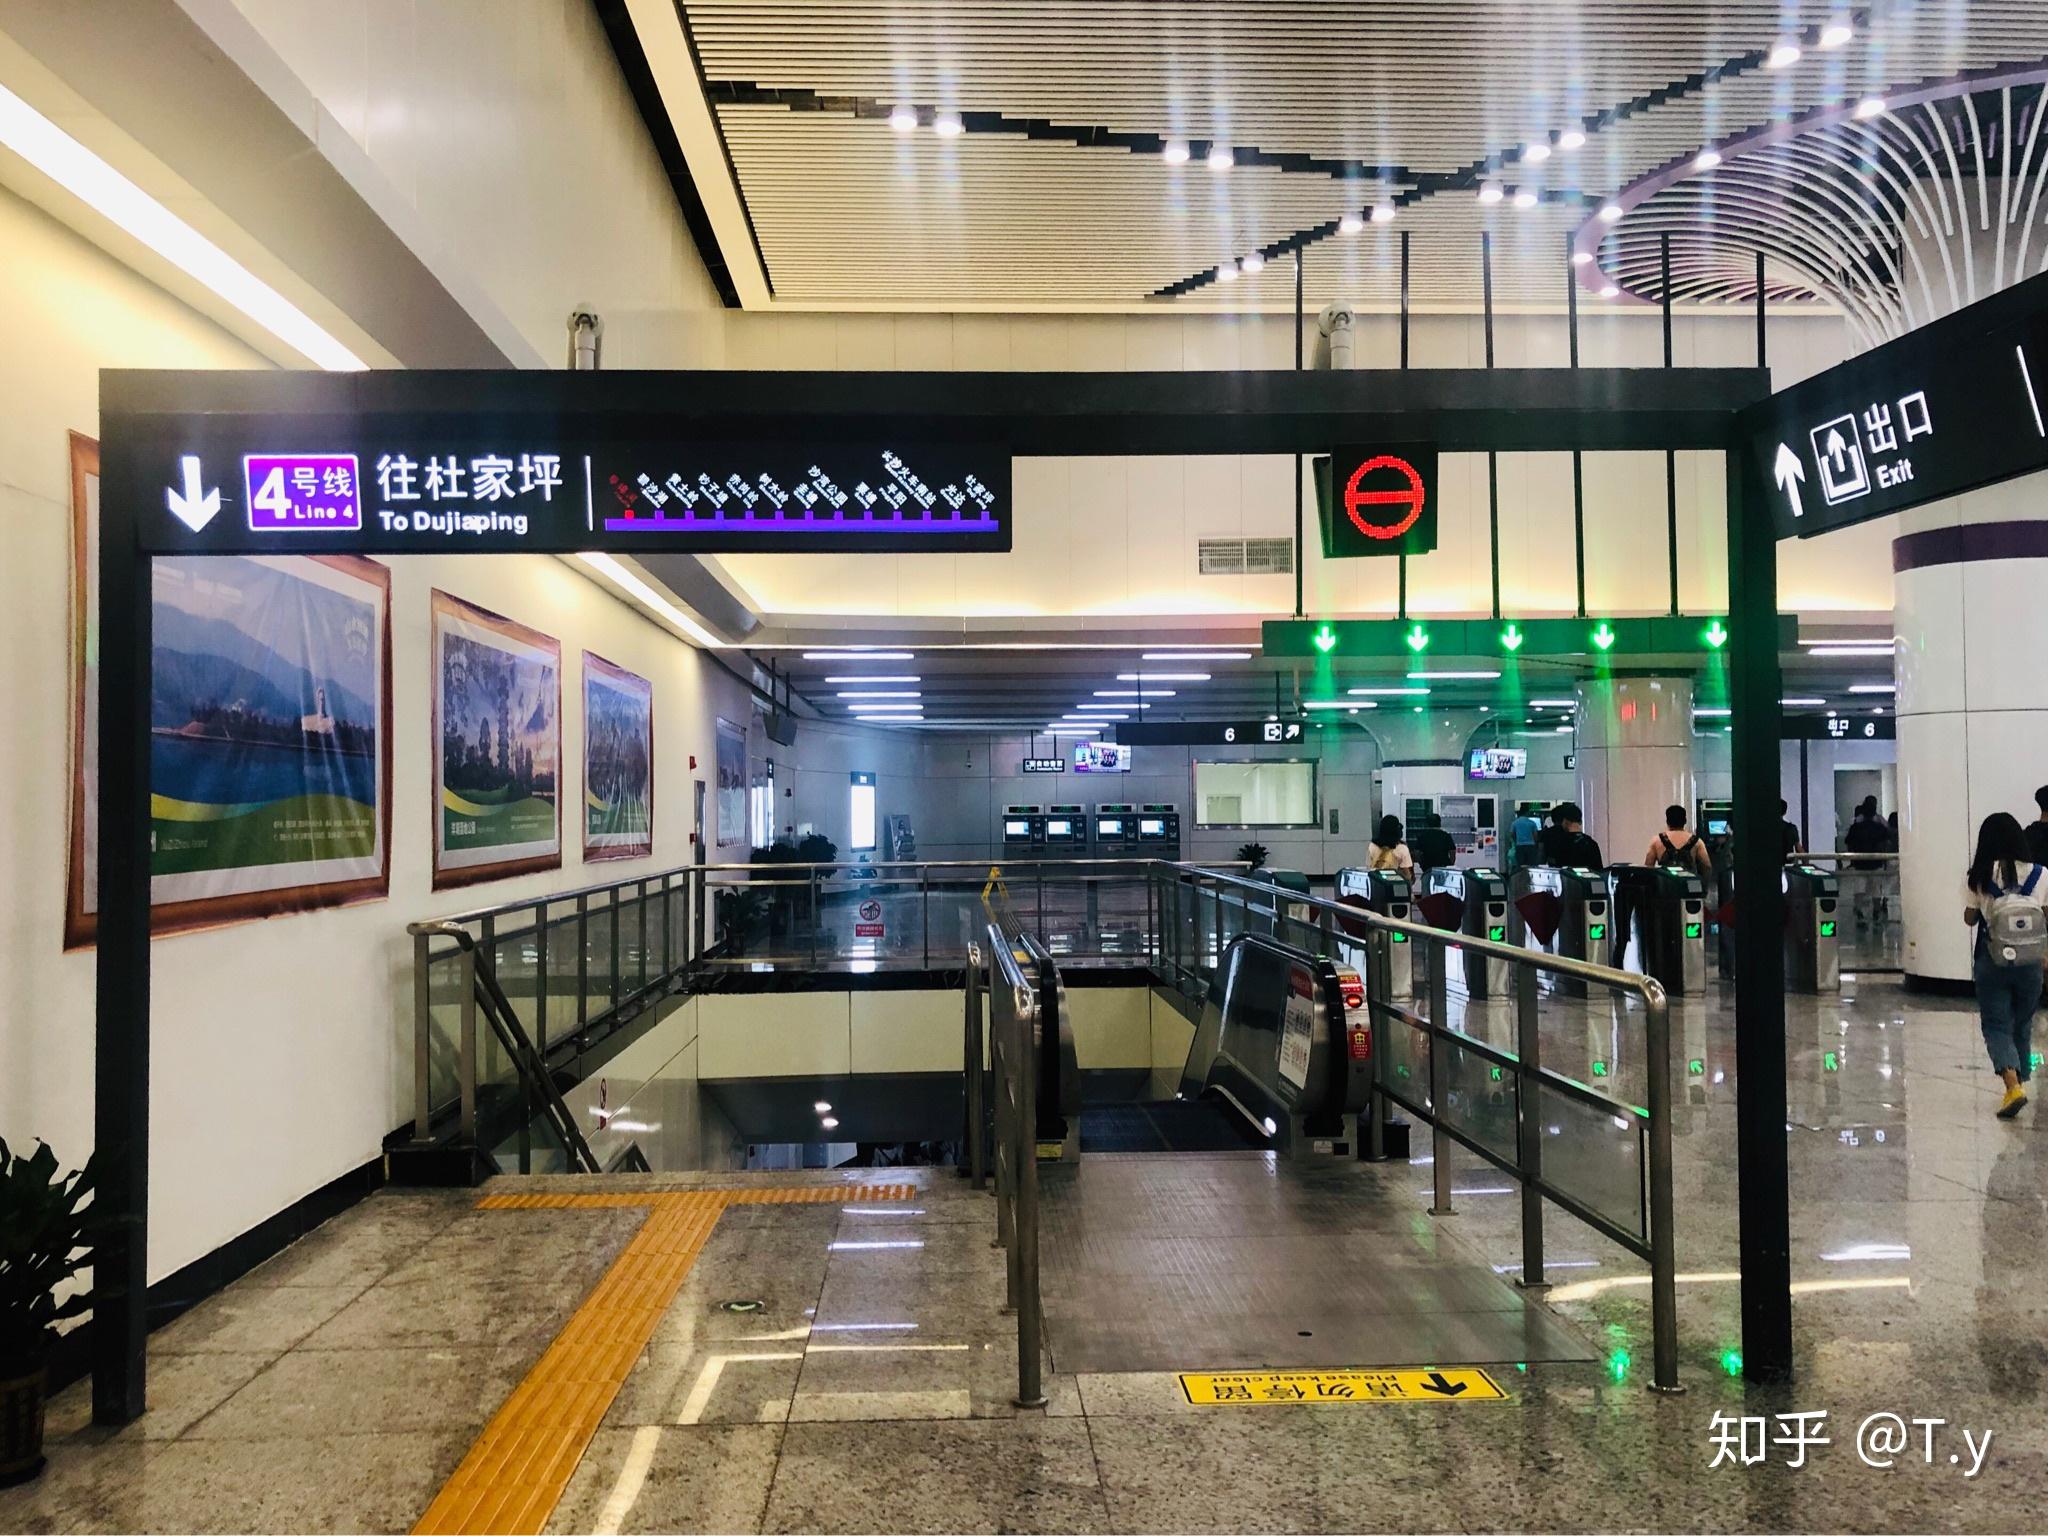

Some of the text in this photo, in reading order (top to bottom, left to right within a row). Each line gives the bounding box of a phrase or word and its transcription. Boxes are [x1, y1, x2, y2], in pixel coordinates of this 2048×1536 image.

[1863, 390, 1933, 454] 出口
[376, 454, 563, 502] 往杜家坪
[808, 465, 848, 505] 沙湾公园
[882, 451, 936, 505] 长沙火车南站
[1875, 458, 1914, 489] Exit
[669, 473, 699, 503] 黄土岭
[729, 474, 759, 503] 赤岗岭
[759, 473, 788, 503] 树木岭
[887, 483, 907, 505] 平阳
[945, 484, 965, 505] 光达
[966, 475, 994, 503] 杜家坪
[294, 503, 355, 519] Line 4
[379, 510, 528, 535] To Dujiaping
[1225, 728, 1235, 741] 6
[1828, 719, 1849, 730] 出口
[1864, 722, 1875, 737] 6
[1211, 1376, 1263, 1384] clear
[1213, 1381, 1409, 1400] 请勿停留
[1269, 1375, 1320, 1383] keep
